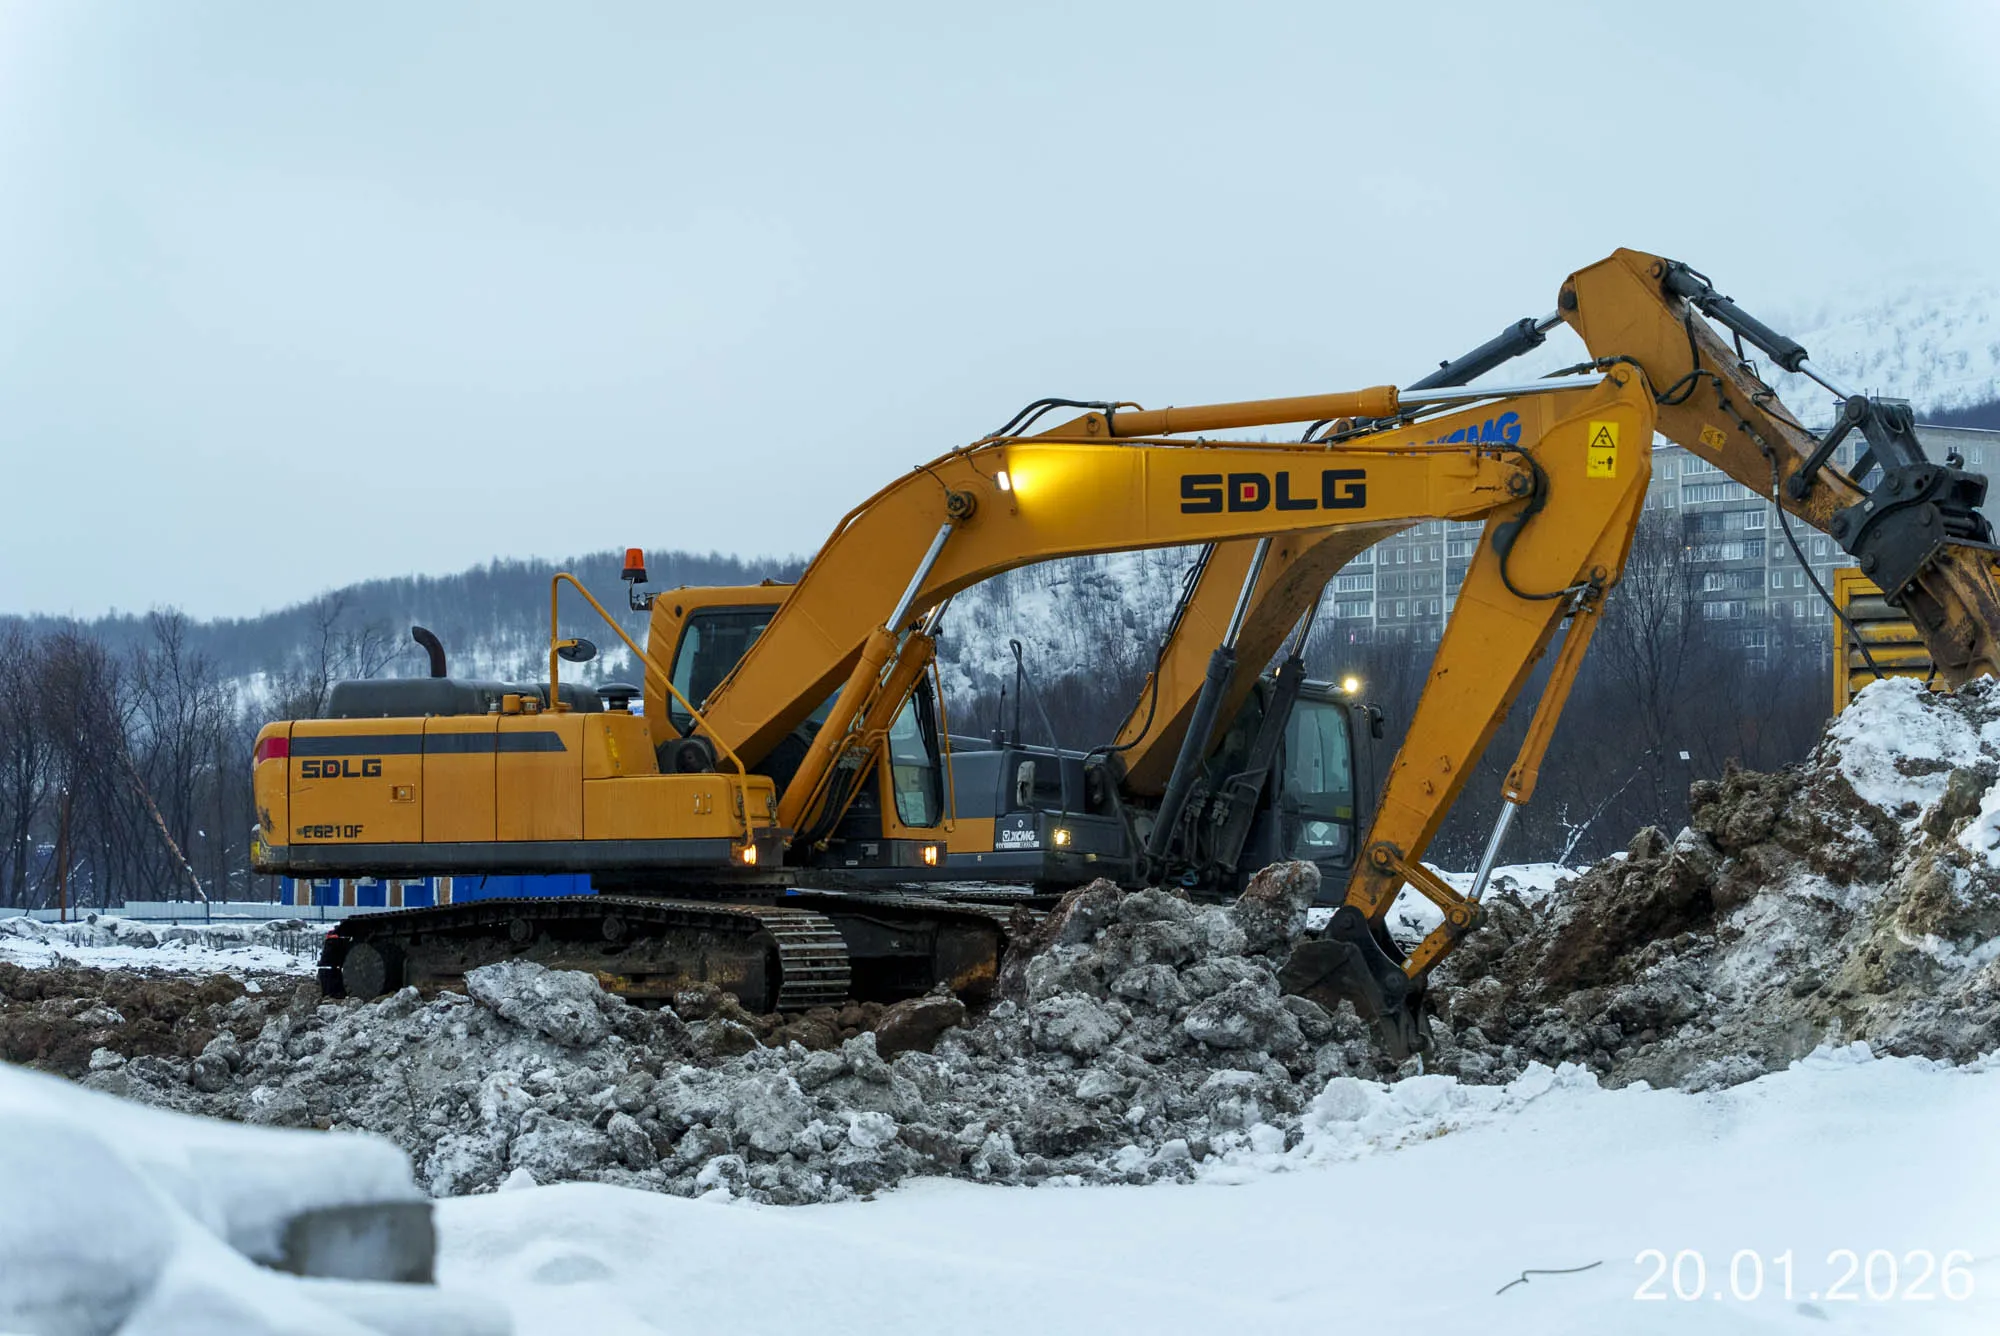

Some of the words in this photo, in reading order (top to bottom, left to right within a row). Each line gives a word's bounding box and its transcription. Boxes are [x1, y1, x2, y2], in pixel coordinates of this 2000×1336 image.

[1180, 469, 1367, 514] SDLG
[302, 759, 382, 778] SDLG
[303, 824, 364, 838] E6210F
